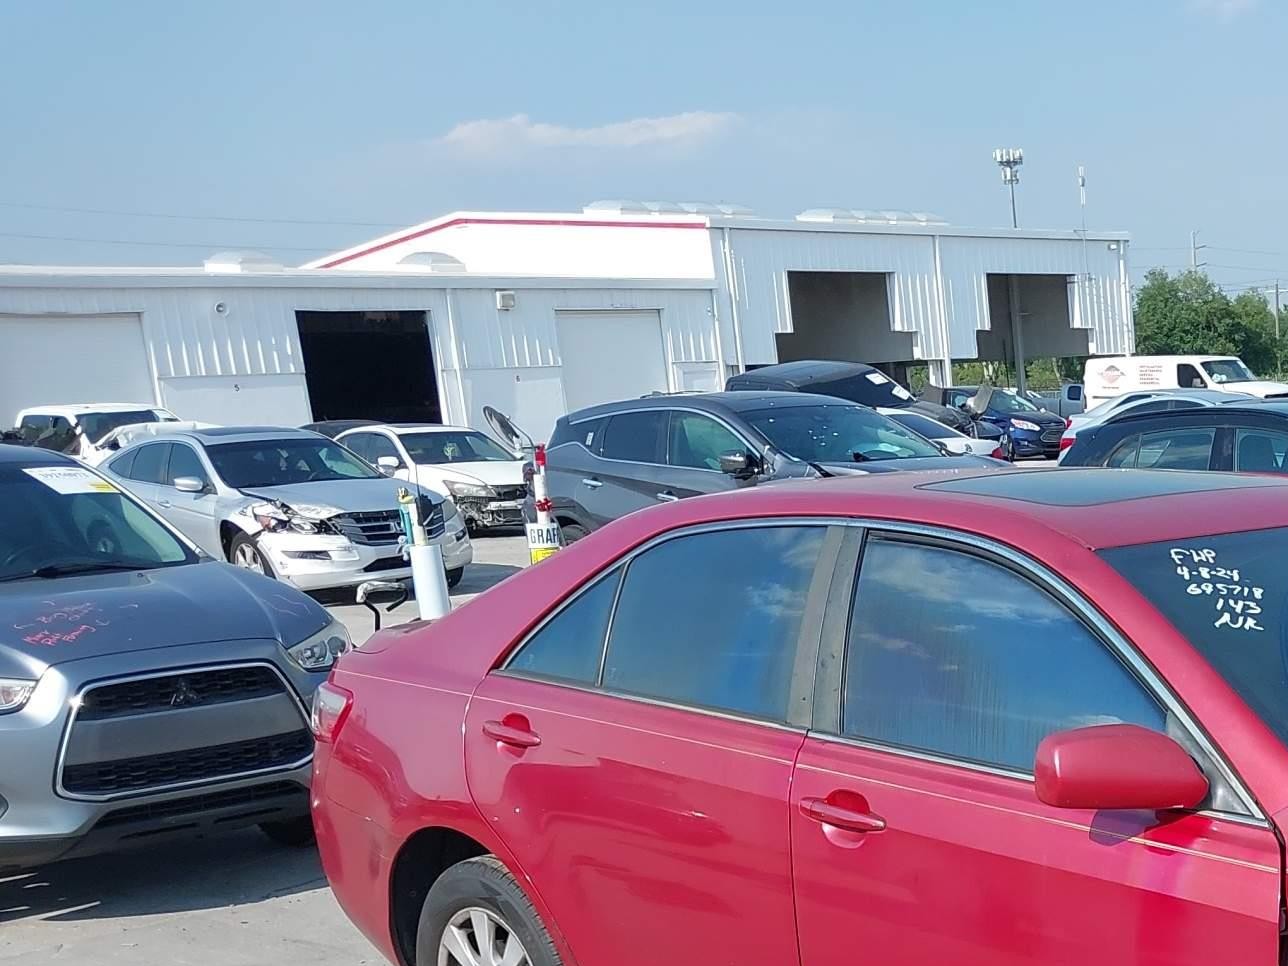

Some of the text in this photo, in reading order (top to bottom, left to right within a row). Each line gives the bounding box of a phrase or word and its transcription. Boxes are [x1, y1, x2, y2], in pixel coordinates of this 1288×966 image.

[1170, 548, 1216, 564] FHP
[1176, 566, 1240, 581] 4-8-24
[1186, 582, 1264, 599] 695718
[1216, 598, 1262, 613] 143
